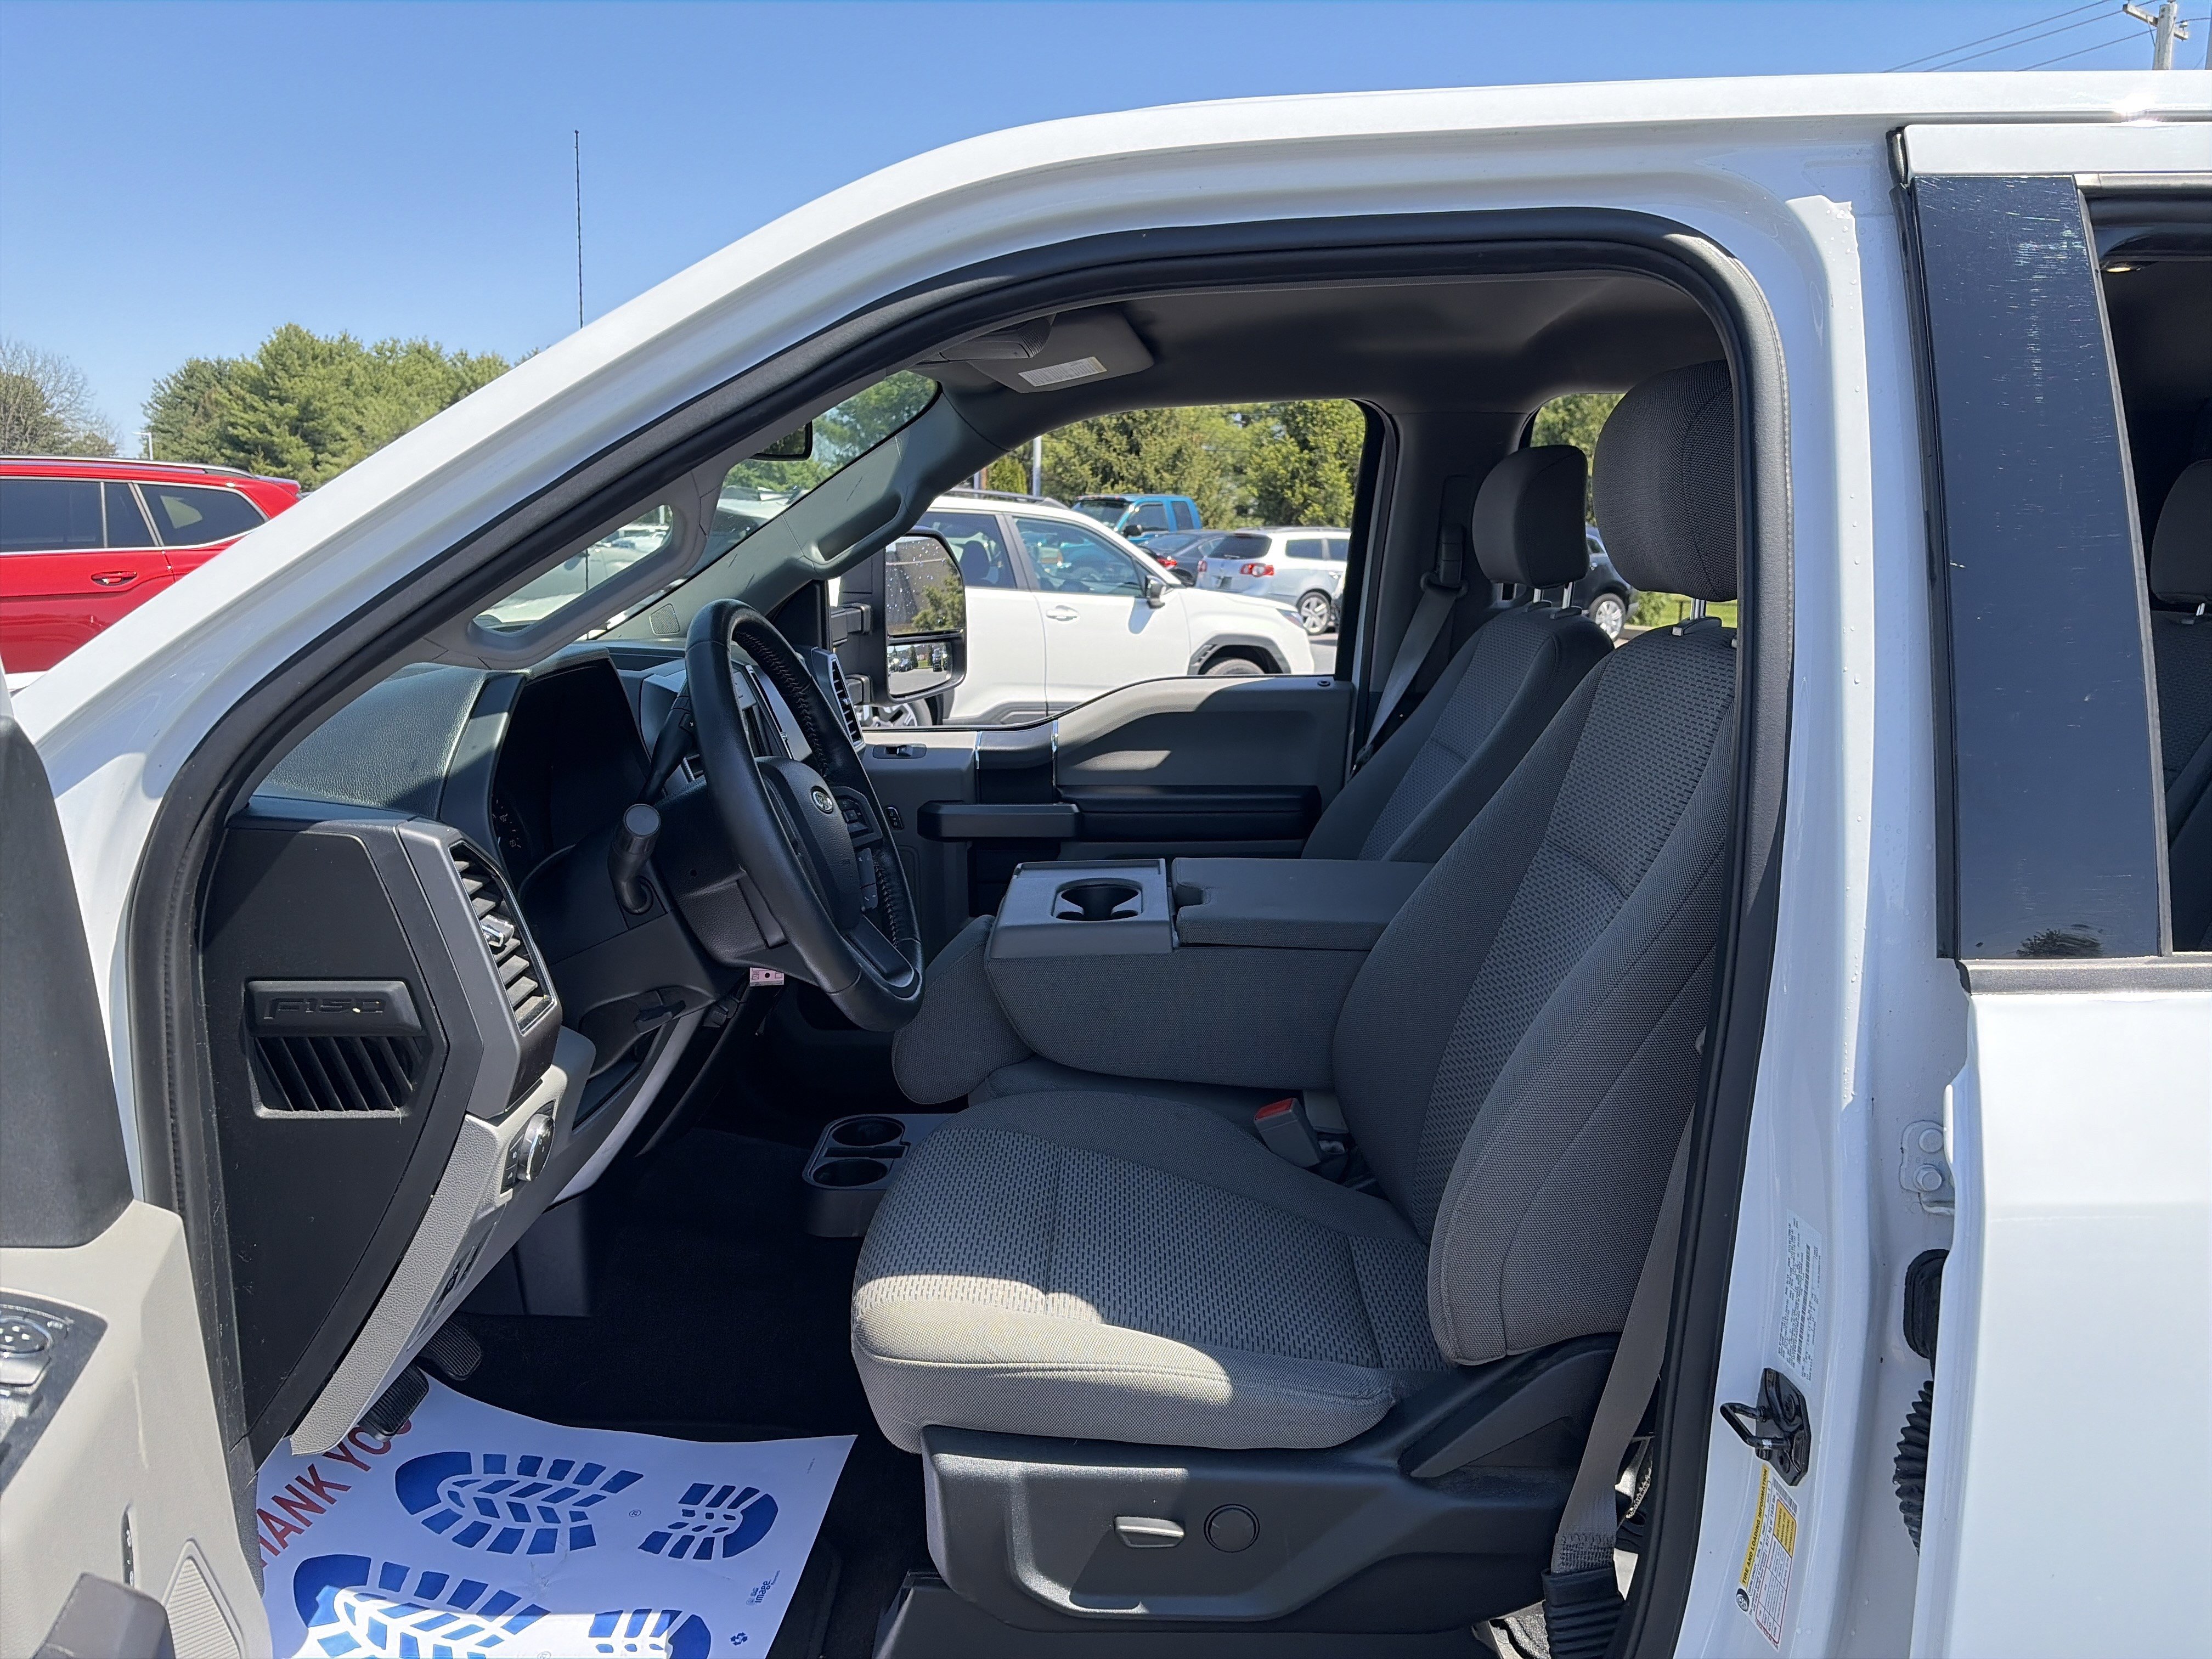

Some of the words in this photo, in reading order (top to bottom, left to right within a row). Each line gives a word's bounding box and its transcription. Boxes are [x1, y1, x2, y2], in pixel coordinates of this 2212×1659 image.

[257, 1463, 352, 1567] ANK
[322, 1419, 412, 1472] YO
[1751, 1519, 1760, 1551] LOADING
[1758, 1468, 1768, 1518] INFORMATION
